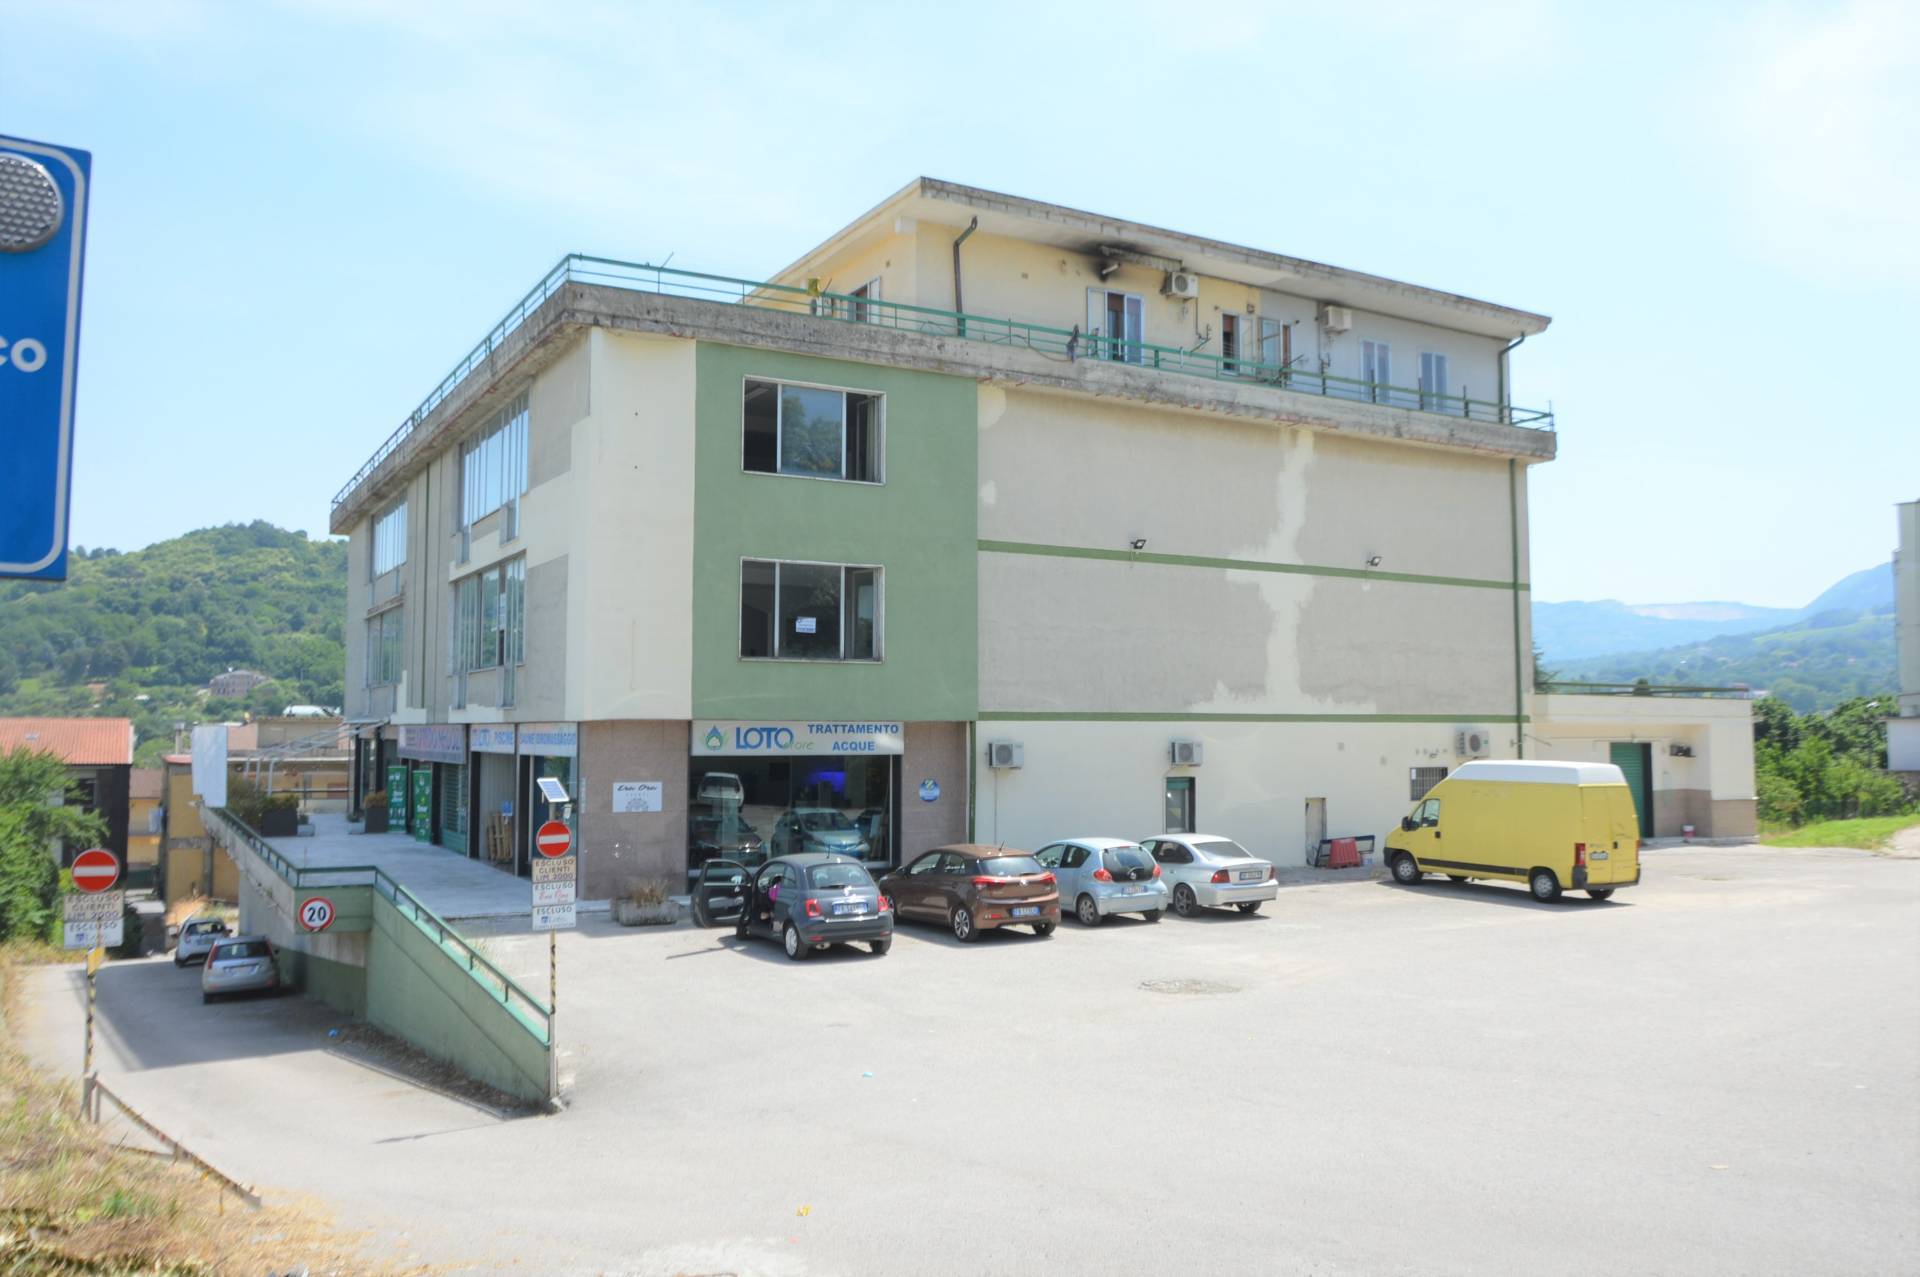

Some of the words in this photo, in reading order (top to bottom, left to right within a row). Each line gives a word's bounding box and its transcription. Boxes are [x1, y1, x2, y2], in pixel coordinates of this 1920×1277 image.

[0, 335, 47, 373] o
[807, 723, 899, 735] TRATTAMENTO
[735, 726, 794, 750] LOTO
[832, 740, 876, 752] ACQUE
[535, 859, 575, 867] ESCLUSO
[535, 883, 574, 891] ESCLUSO
[67, 895, 120, 904] ESCLUSO
[72, 903, 115, 912] CLIENTI
[536, 906, 573, 915] ESCLUSO
[307, 906, 327, 922] 20
